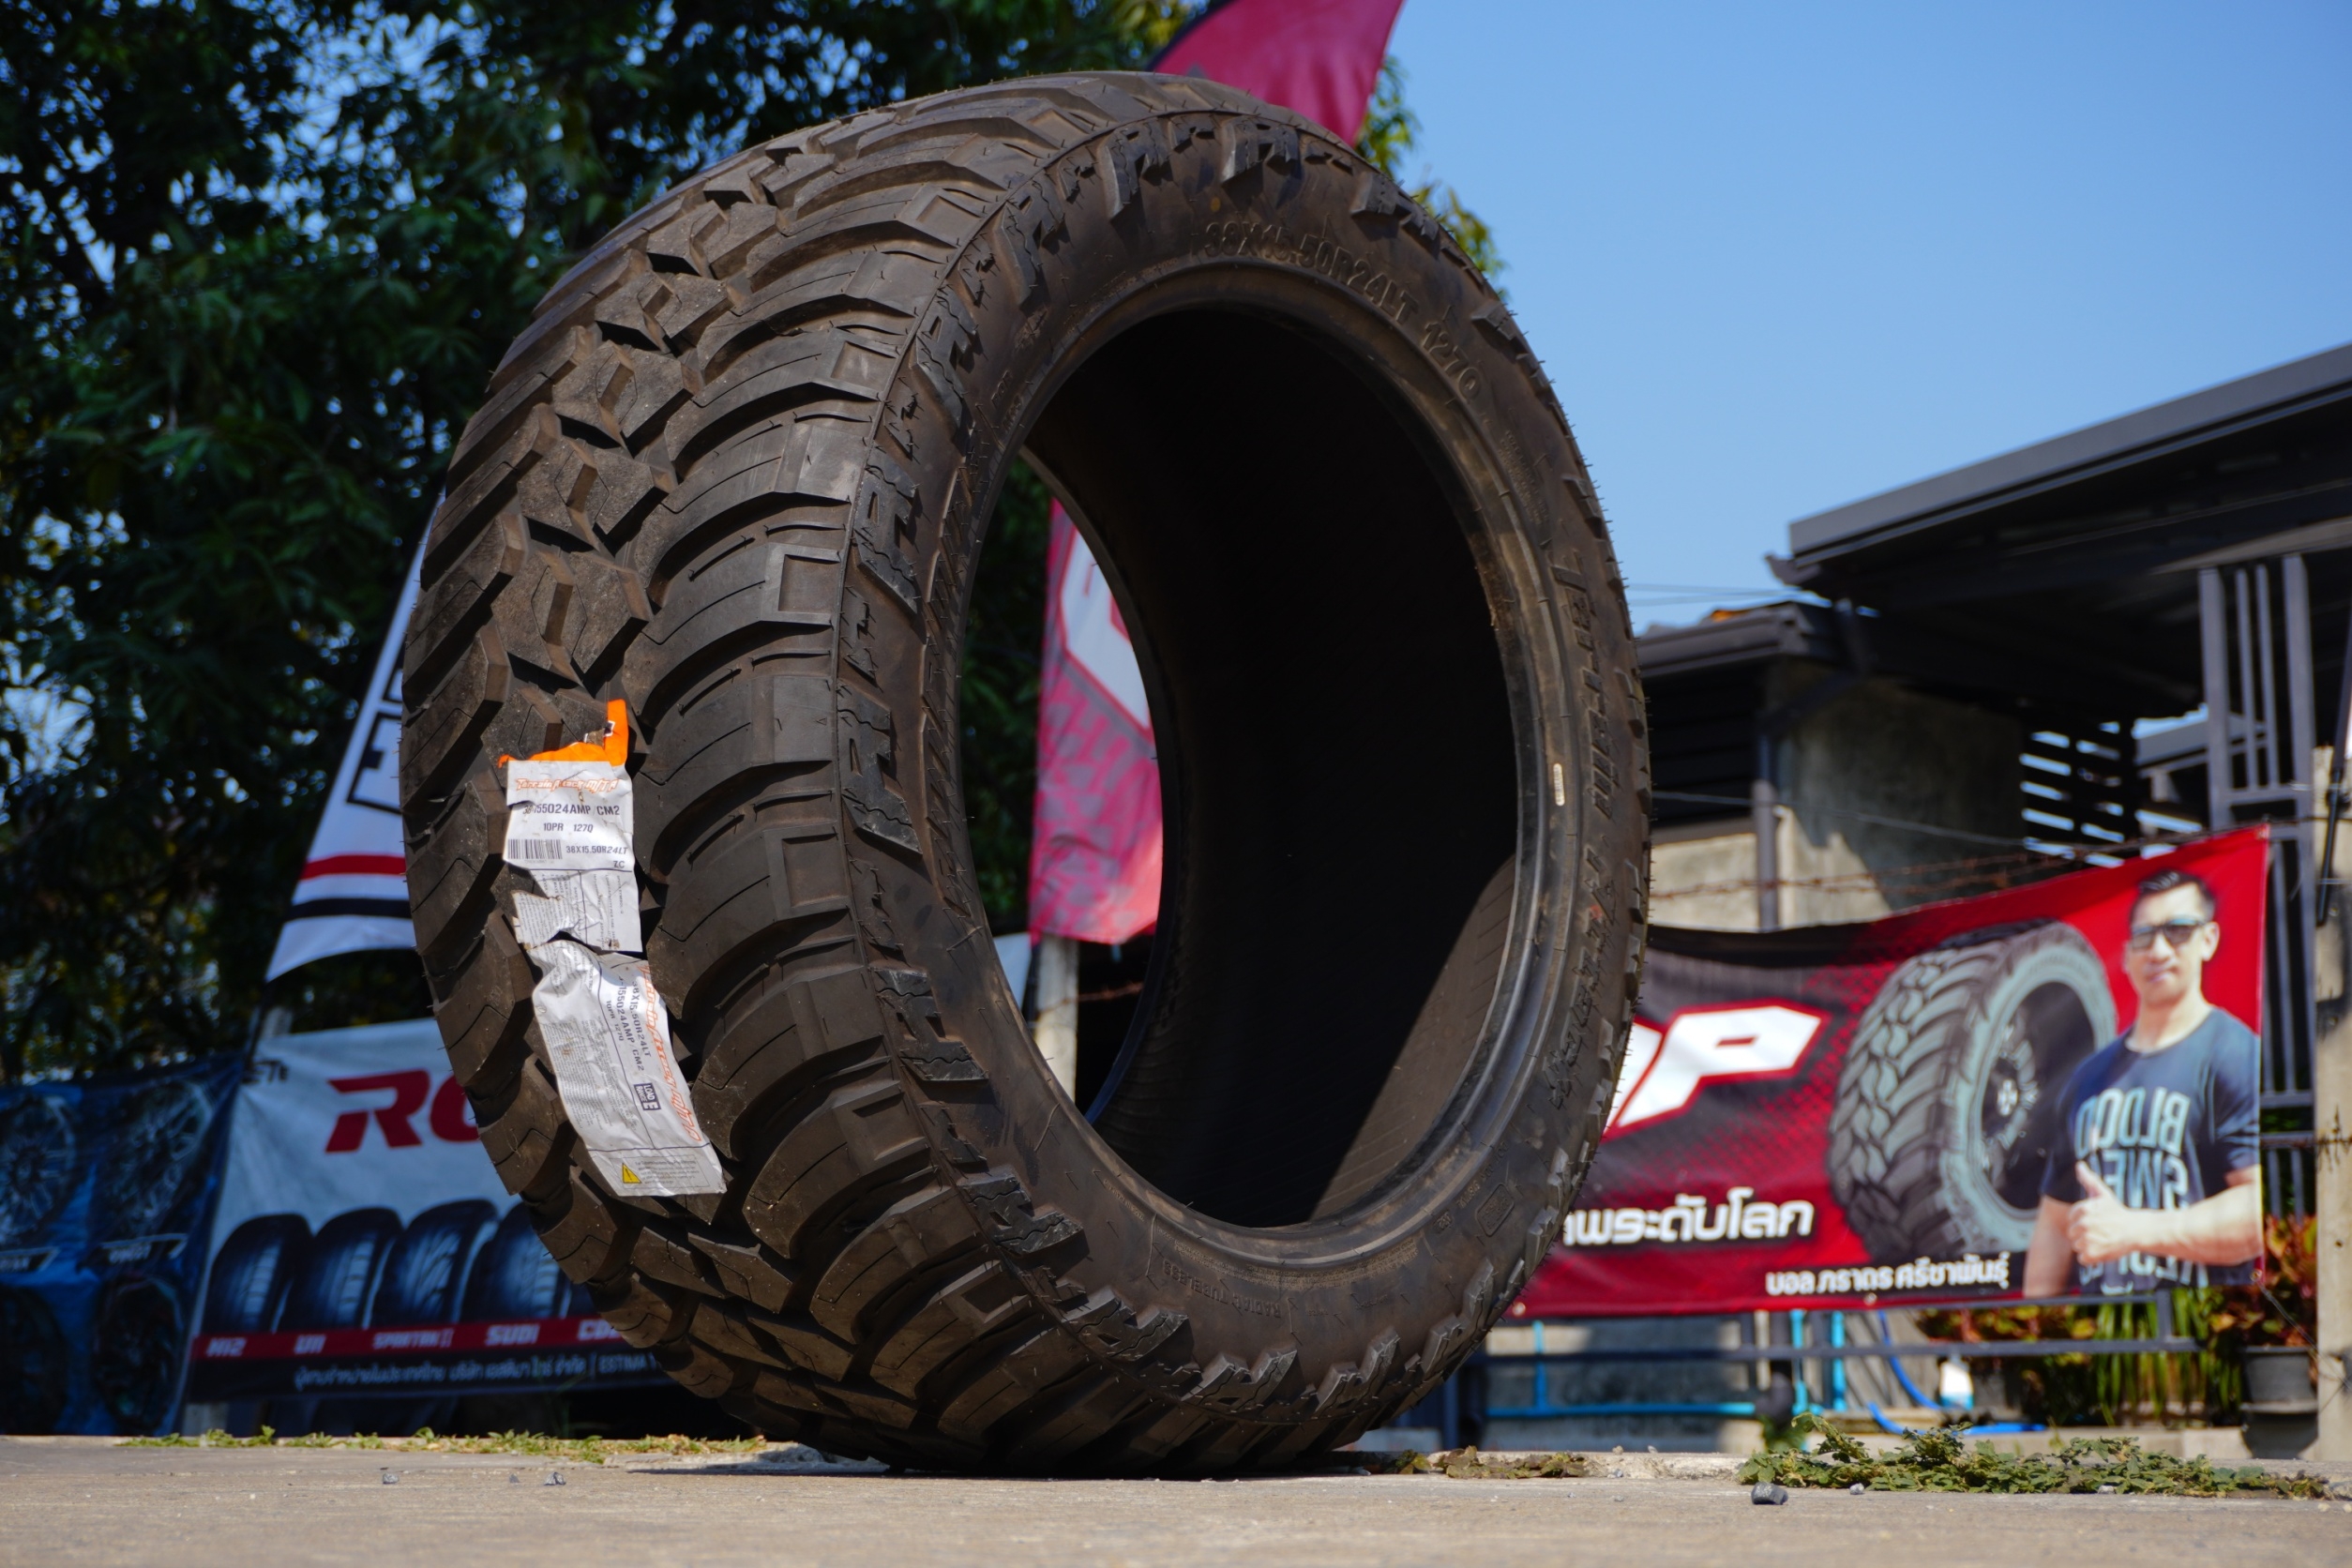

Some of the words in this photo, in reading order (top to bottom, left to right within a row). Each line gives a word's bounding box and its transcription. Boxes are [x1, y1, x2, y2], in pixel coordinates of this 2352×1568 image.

[1422, 322, 1482, 400] 127Q
[543, 822, 564, 832] 10PR
[573, 823, 594, 833] 127Q
[565, 845, 628, 855] 38X15.50R24LT
[1162, 1259, 1230, 1306] TUBELESS
